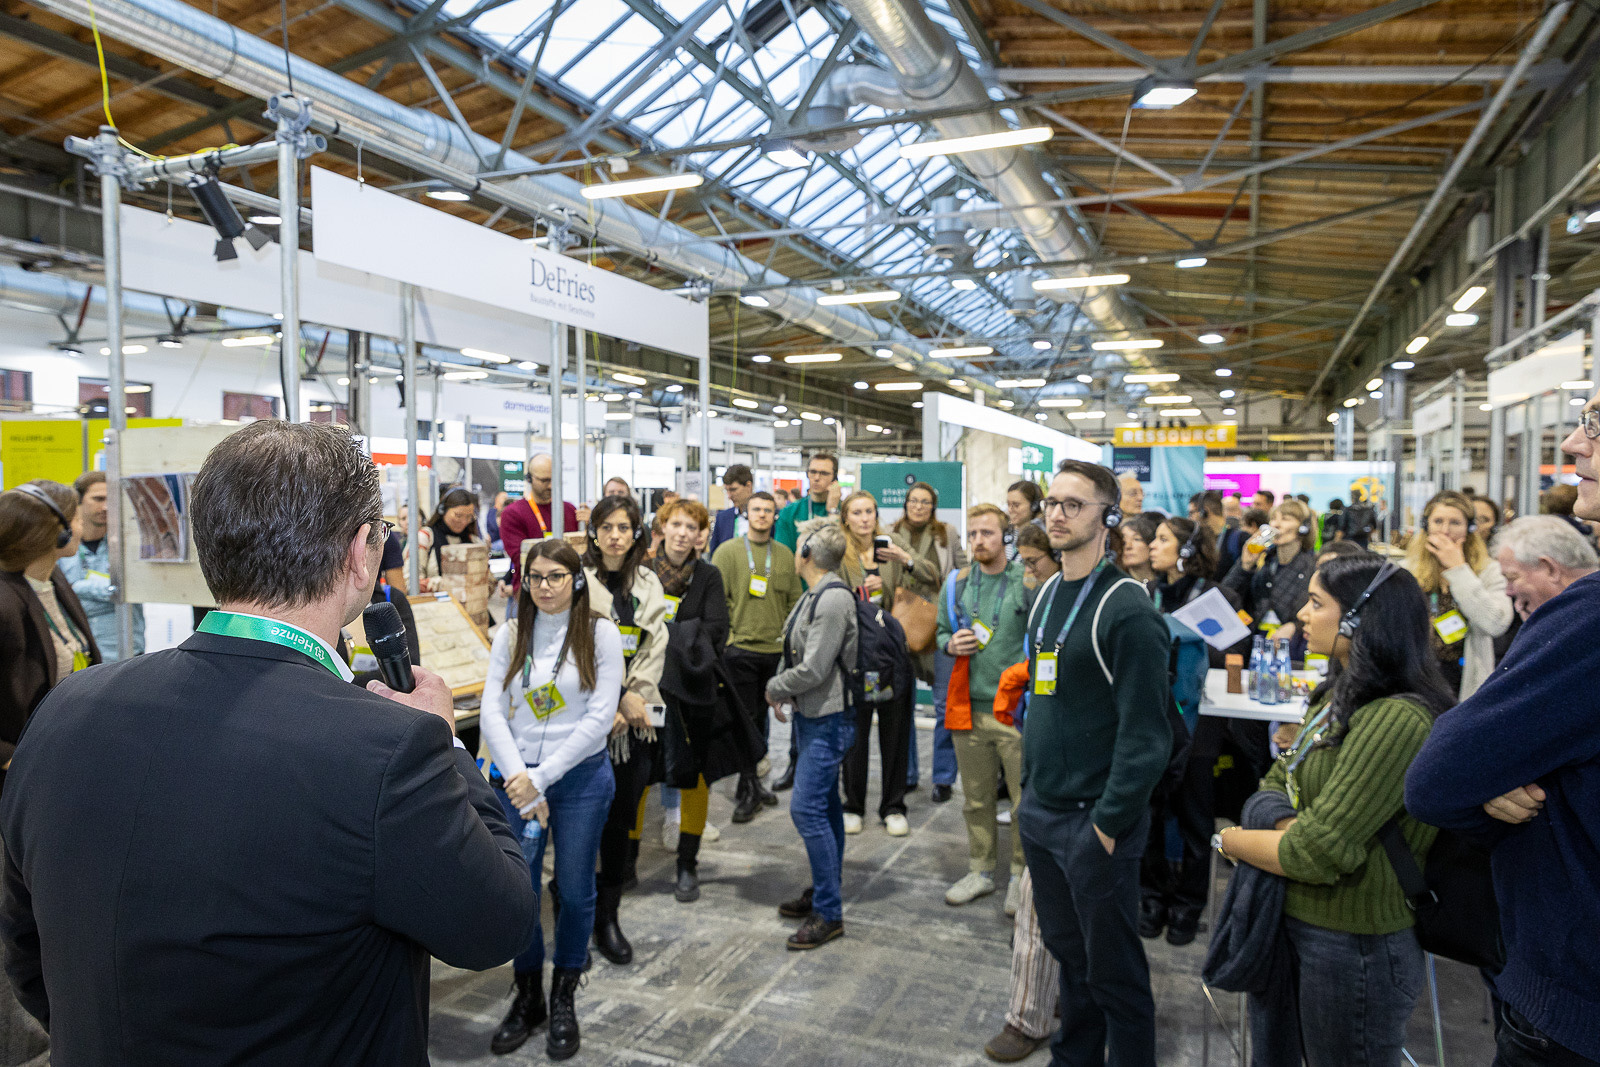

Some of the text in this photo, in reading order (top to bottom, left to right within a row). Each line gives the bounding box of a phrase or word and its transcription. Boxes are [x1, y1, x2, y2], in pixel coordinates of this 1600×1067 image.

[531, 258, 595, 303] DeFries
[1122, 428, 1229, 443] RESSOURCE
[270, 626, 314, 653] Heinze
